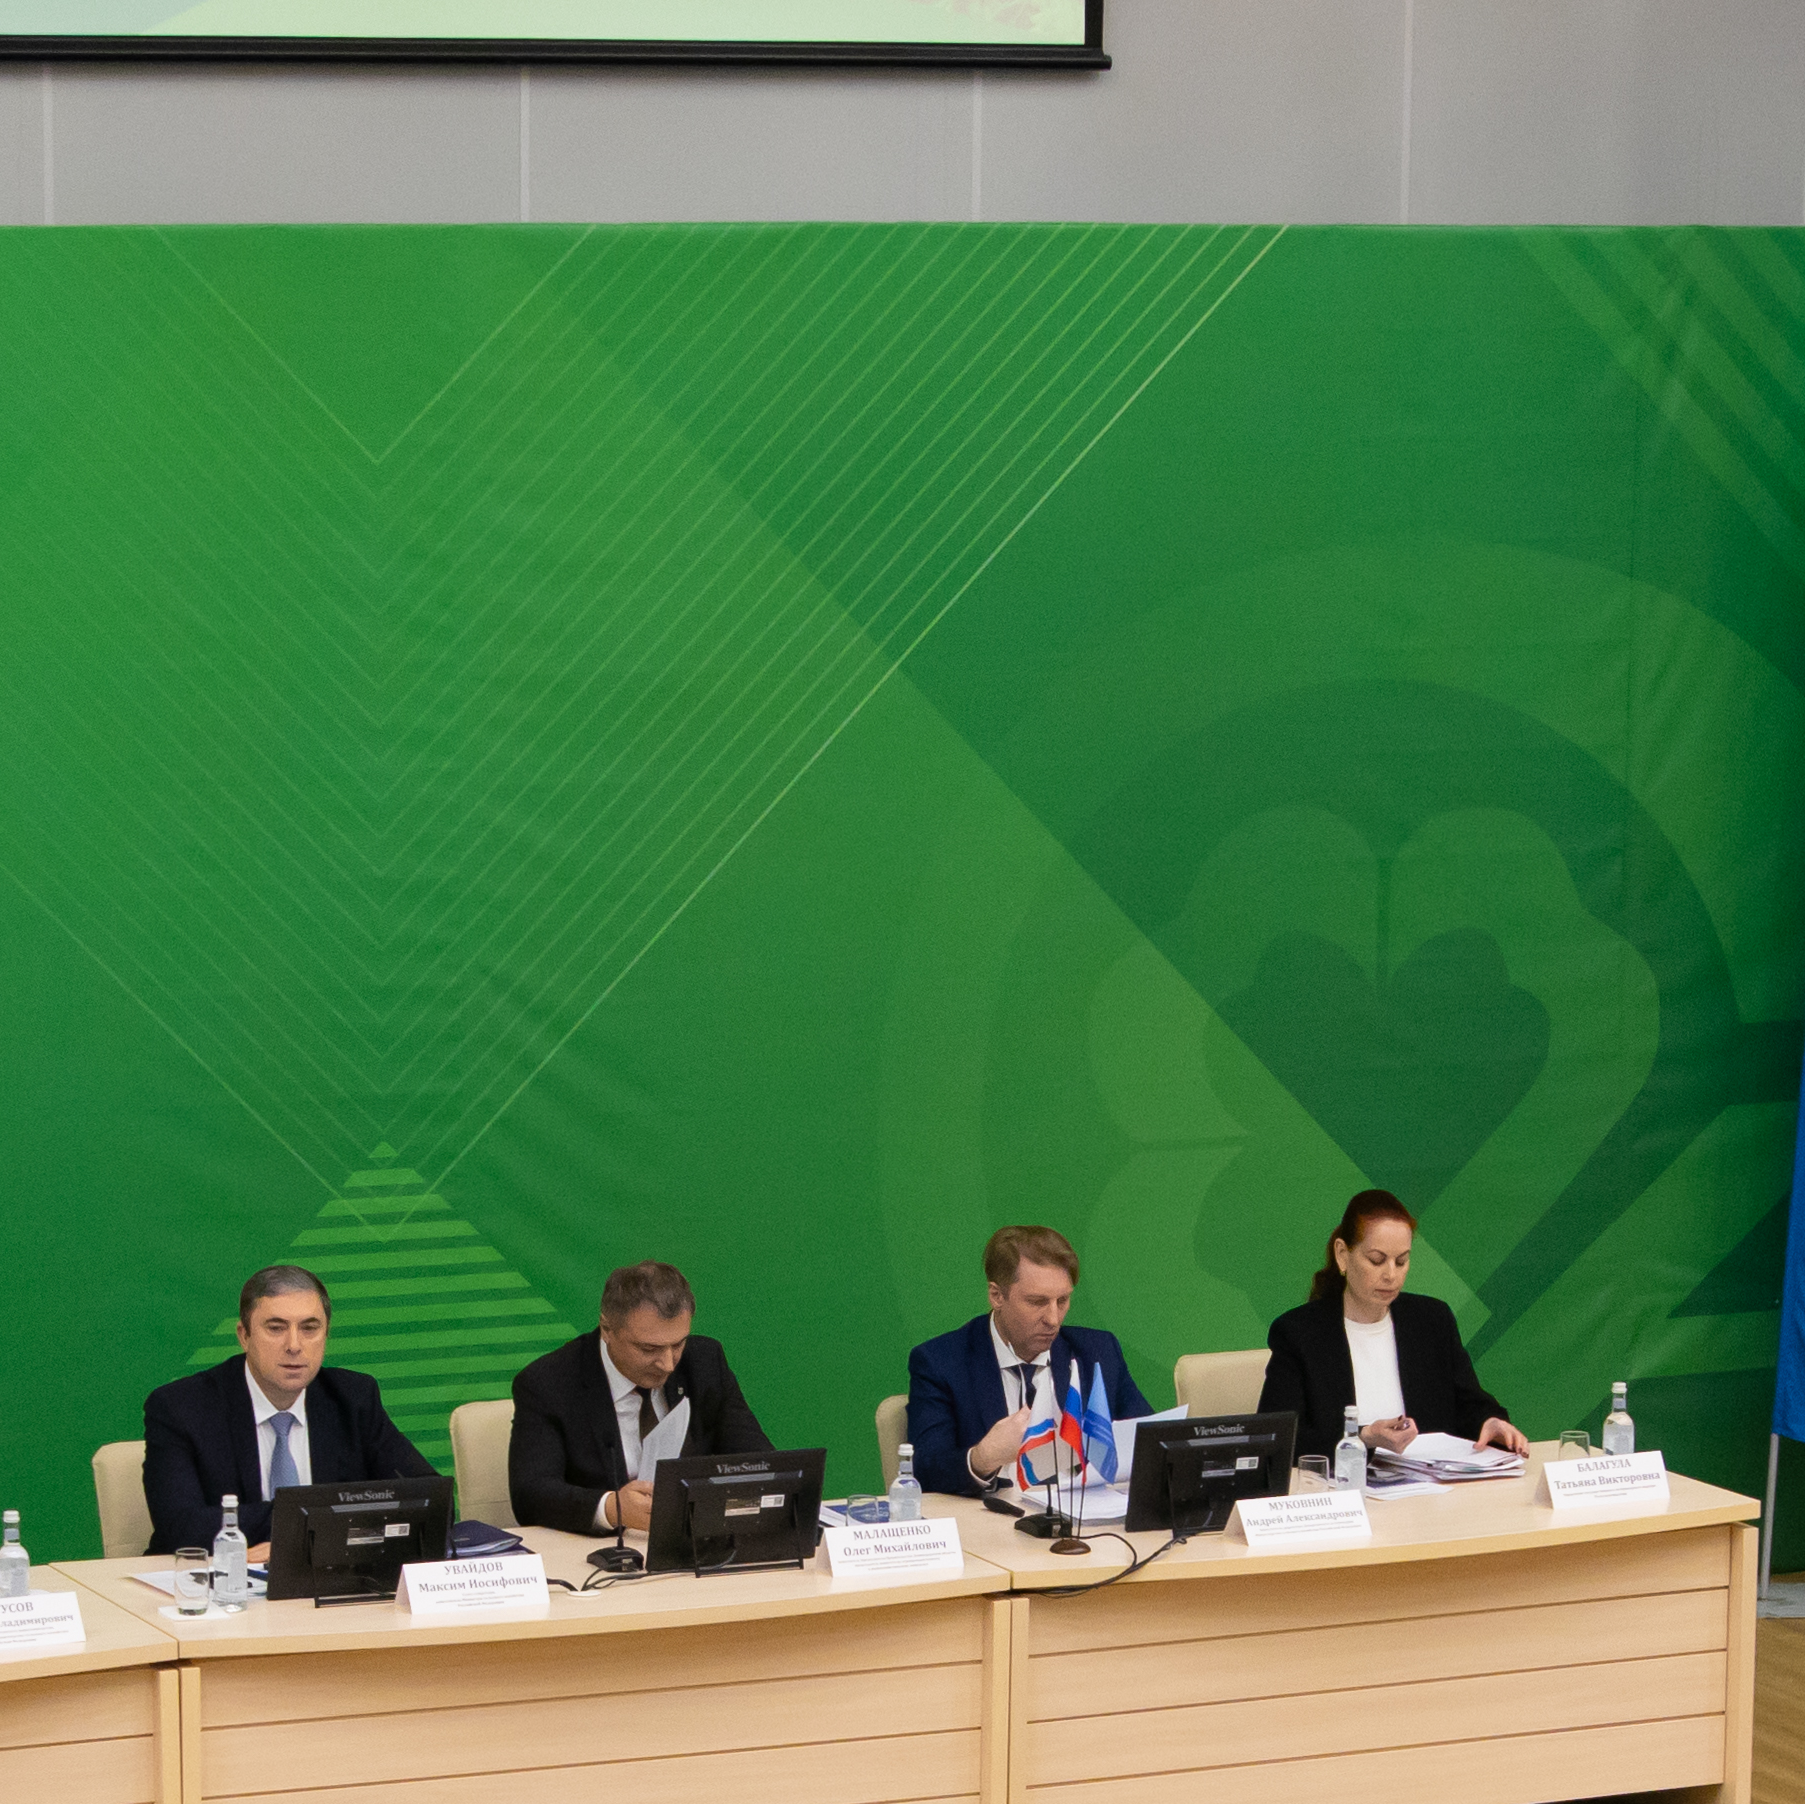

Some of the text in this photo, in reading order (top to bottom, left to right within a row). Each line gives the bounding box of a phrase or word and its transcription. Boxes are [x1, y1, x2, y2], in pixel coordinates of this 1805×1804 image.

[1193, 1422, 1246, 1437] ViewSonic
[716, 1460, 771, 1474] ViewSonic
[1576, 1458, 1632, 1473] БАЛАГУЛА
[1554, 1479, 1597, 1491] Татьяна
[1598, 1472, 1661, 1486] Викторовна
[337, 1489, 396, 1503] ViewSonic
[1268, 1497, 1333, 1512] МУКОВНИН
[1246, 1509, 1364, 1528] Андрей Александрович
[853, 1524, 932, 1541] МАЛАЩЕНКО
[843, 1540, 948, 1557] Олег Михайлович
[444, 1561, 504, 1575] УВАЙДОВ
[418, 1575, 539, 1593] Максим Иосифович
